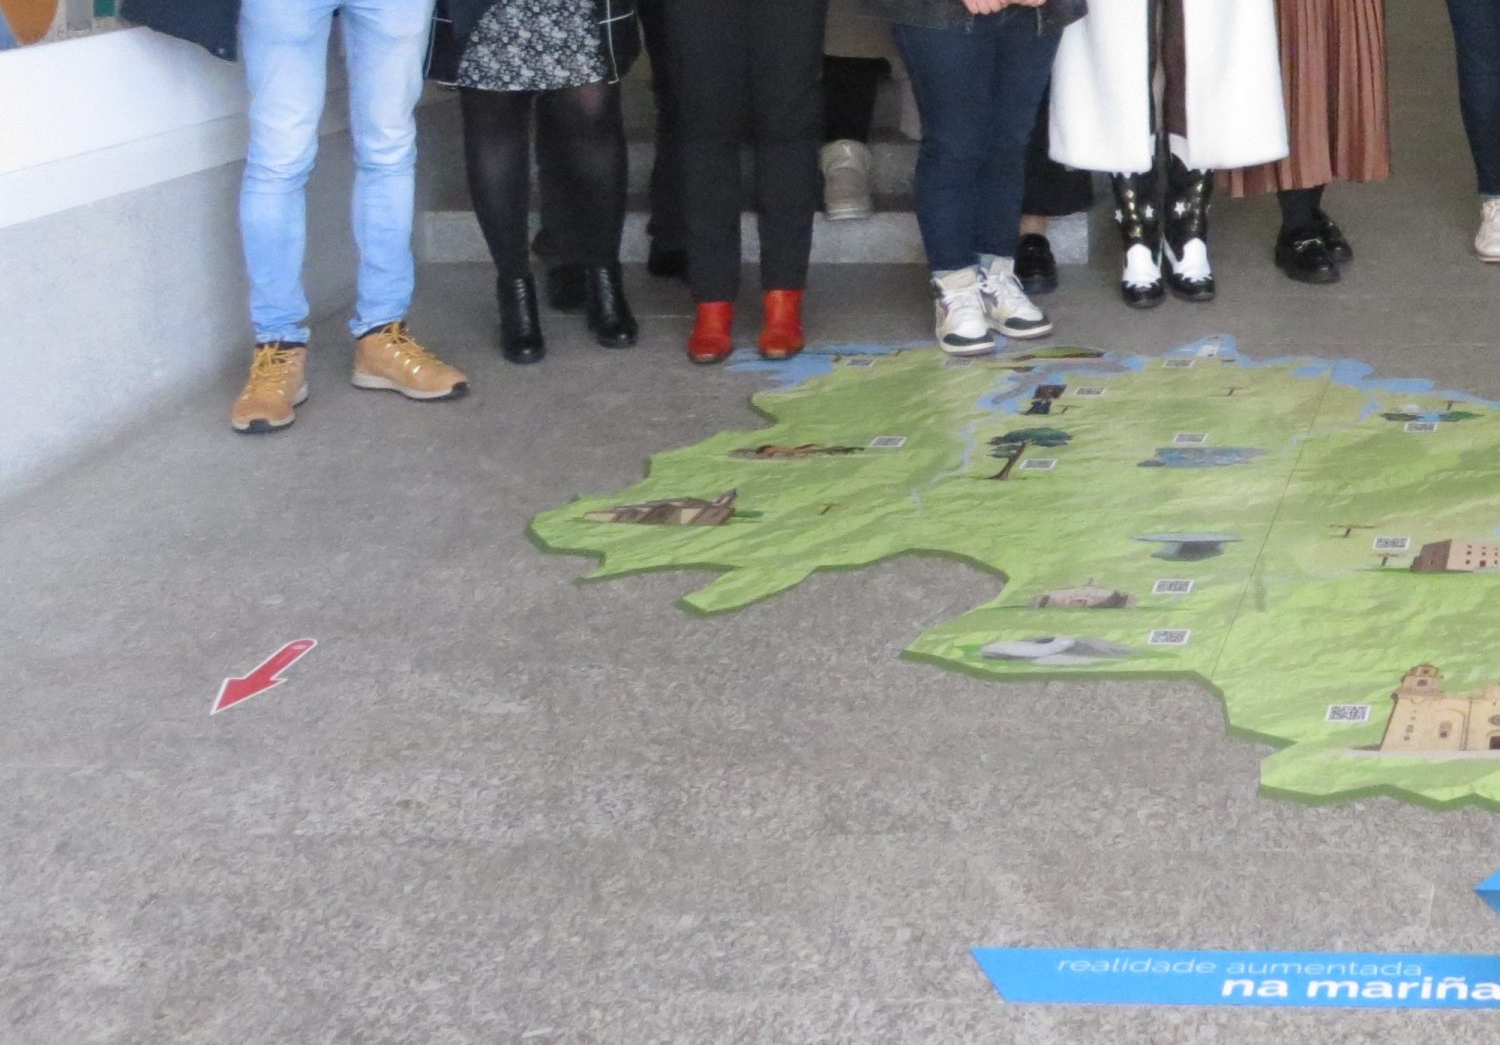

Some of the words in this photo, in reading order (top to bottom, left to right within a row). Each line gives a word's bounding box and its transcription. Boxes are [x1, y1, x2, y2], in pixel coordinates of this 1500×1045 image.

[1057, 957, 1216, 974] realidade
[1226, 960, 1422, 977] aumentada
[1221, 977, 1289, 997] na
